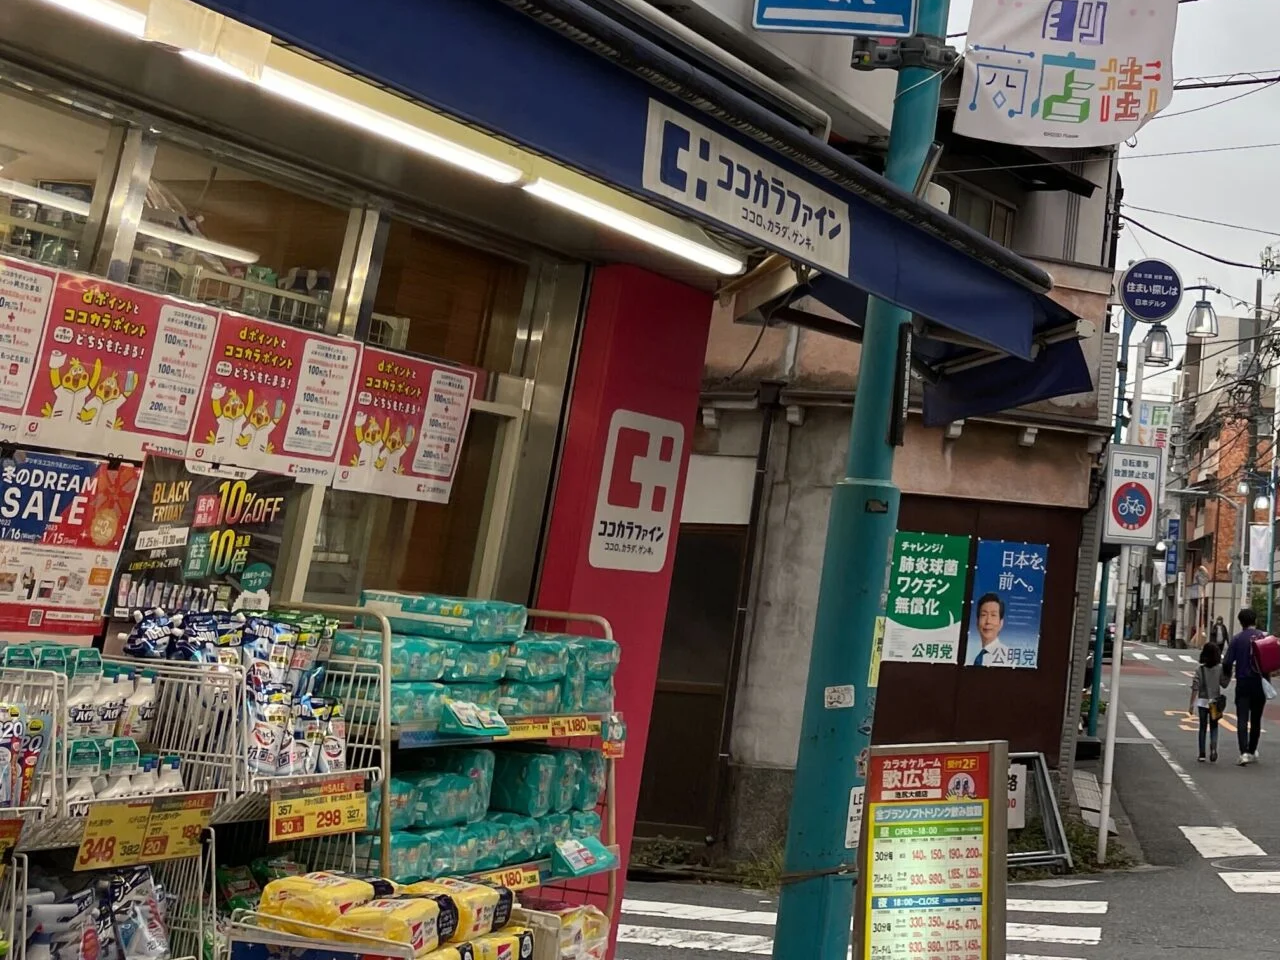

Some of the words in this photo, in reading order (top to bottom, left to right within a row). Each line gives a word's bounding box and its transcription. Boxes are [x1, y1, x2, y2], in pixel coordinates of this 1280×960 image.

[717, 155, 842, 240] ココカラファイン
[1126, 282, 1178, 296] 住まい探しは
[64, 308, 148, 337] ココカラポイント
[225, 345, 293, 369] ココカラポイント
[366, 376, 422, 397] ココカラポイント
[152, 480, 192, 505] BLACK
[1, 487, 89, 526] SALE
[151, 504, 185, 524] FRIDAY
[598, 520, 665, 542] ココカラファイン
[898, 555, 959, 577] 肺炎球菌
[896, 576, 951, 595] ワクチン
[894, 596, 940, 616] 無償化
[911, 643, 953, 660] 公明党
[991, 647, 1036, 666] 公明党
[883, 757, 941, 769] カラオケルーム
[882, 767, 942, 789] 歌広場
[316, 809, 342, 829] 298
[79, 836, 116, 865] 348
